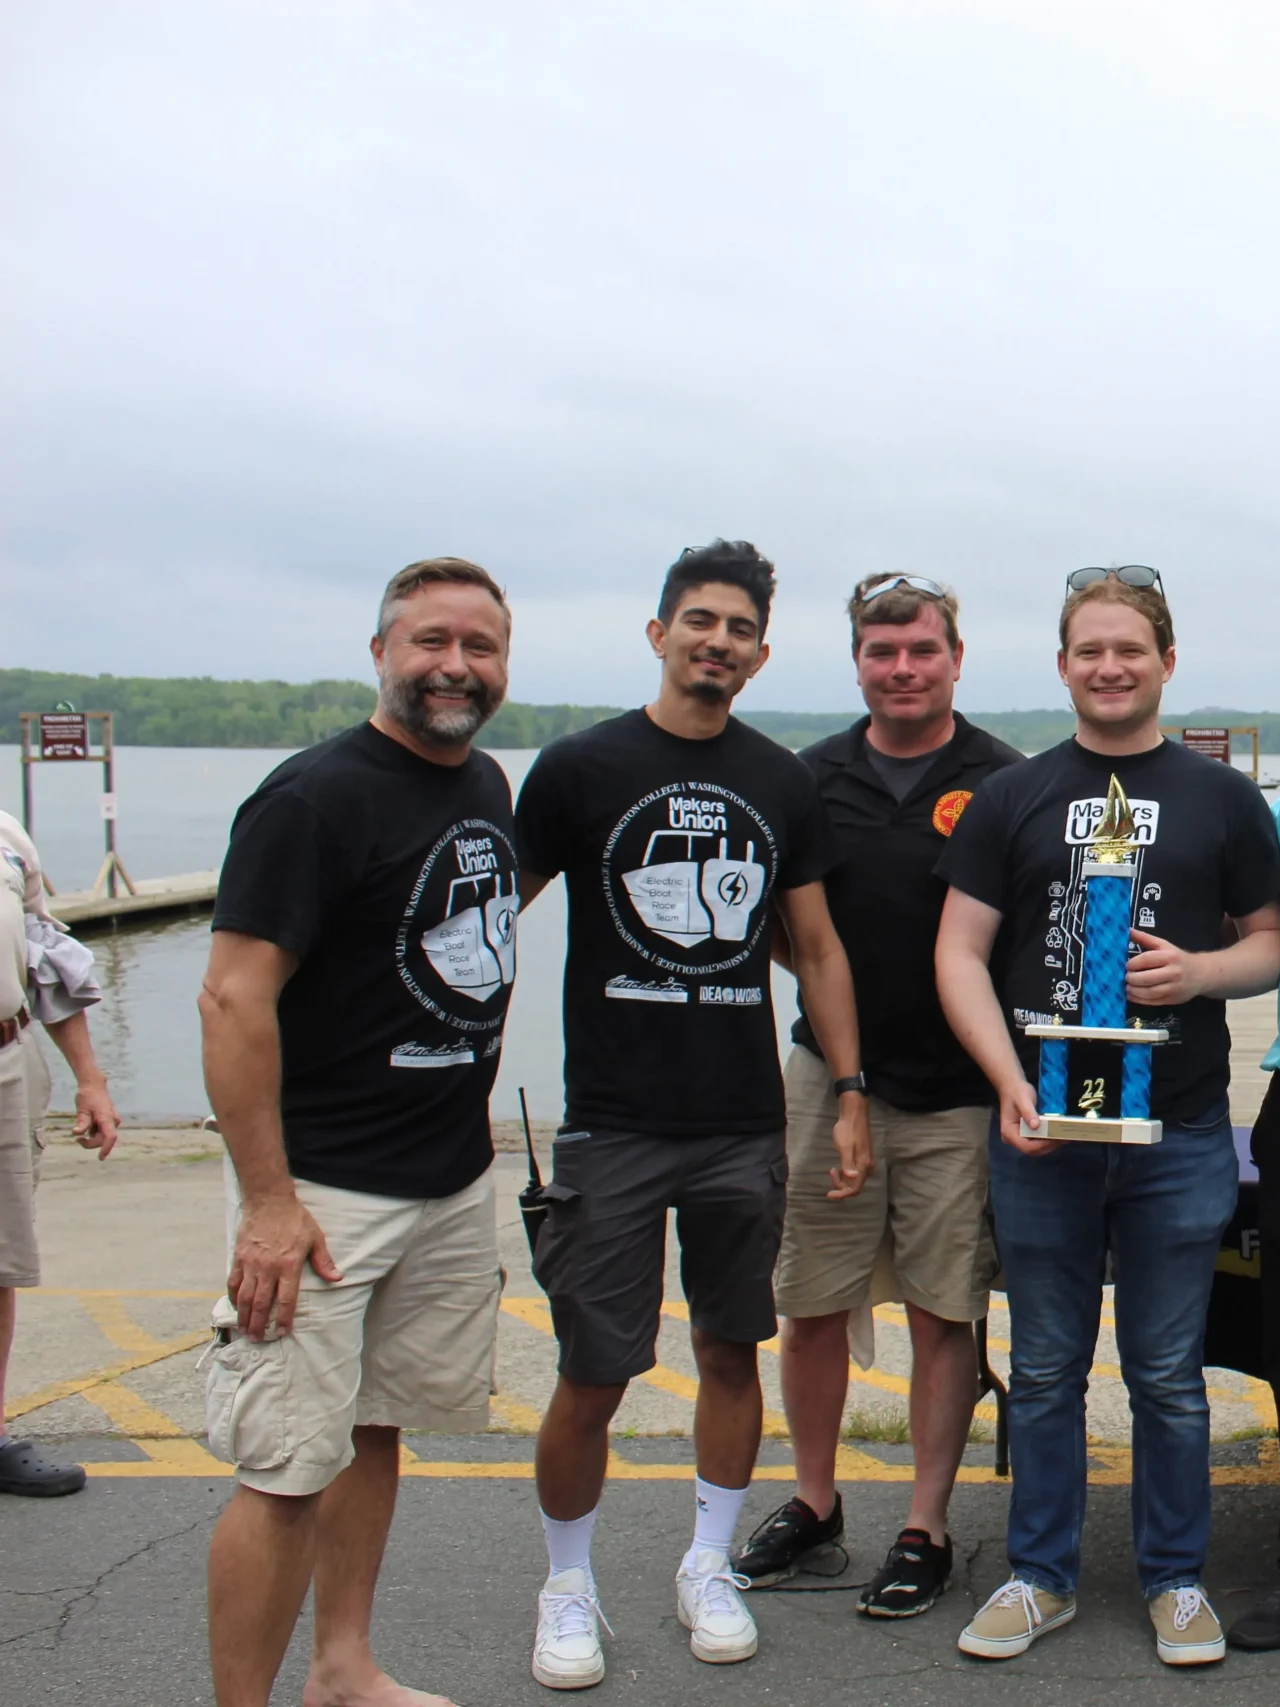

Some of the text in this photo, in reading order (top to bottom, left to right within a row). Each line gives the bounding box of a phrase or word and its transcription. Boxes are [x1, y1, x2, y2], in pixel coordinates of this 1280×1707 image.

[669, 797, 725, 813] Makers
[688, 781, 775, 845] WASHINGTON COLLEGE
[1073, 802, 1153, 819] Mars
[602, 782, 681, 859] WASHINGTON COLLEGE
[669, 809, 727, 831] Union
[455, 837, 493, 855] Makers
[403, 824, 460, 917] WASHINGTON COLLEGE
[457, 852, 498, 875] Union
[647, 876, 684, 886] Electric
[649, 888, 671, 898] Boat
[652, 901, 676, 910] Race
[655, 913, 679, 922] Team
[440, 926, 472, 939] Electric
[610, 907, 650, 960] WASHINGTON
[448, 954, 470, 964] Race
[655, 956, 698, 975] COLLEGE
[453, 967, 475, 977] Team
[398, 967, 447, 1021] WASHINGTON
[1081, 1077, 1105, 1098] 22
